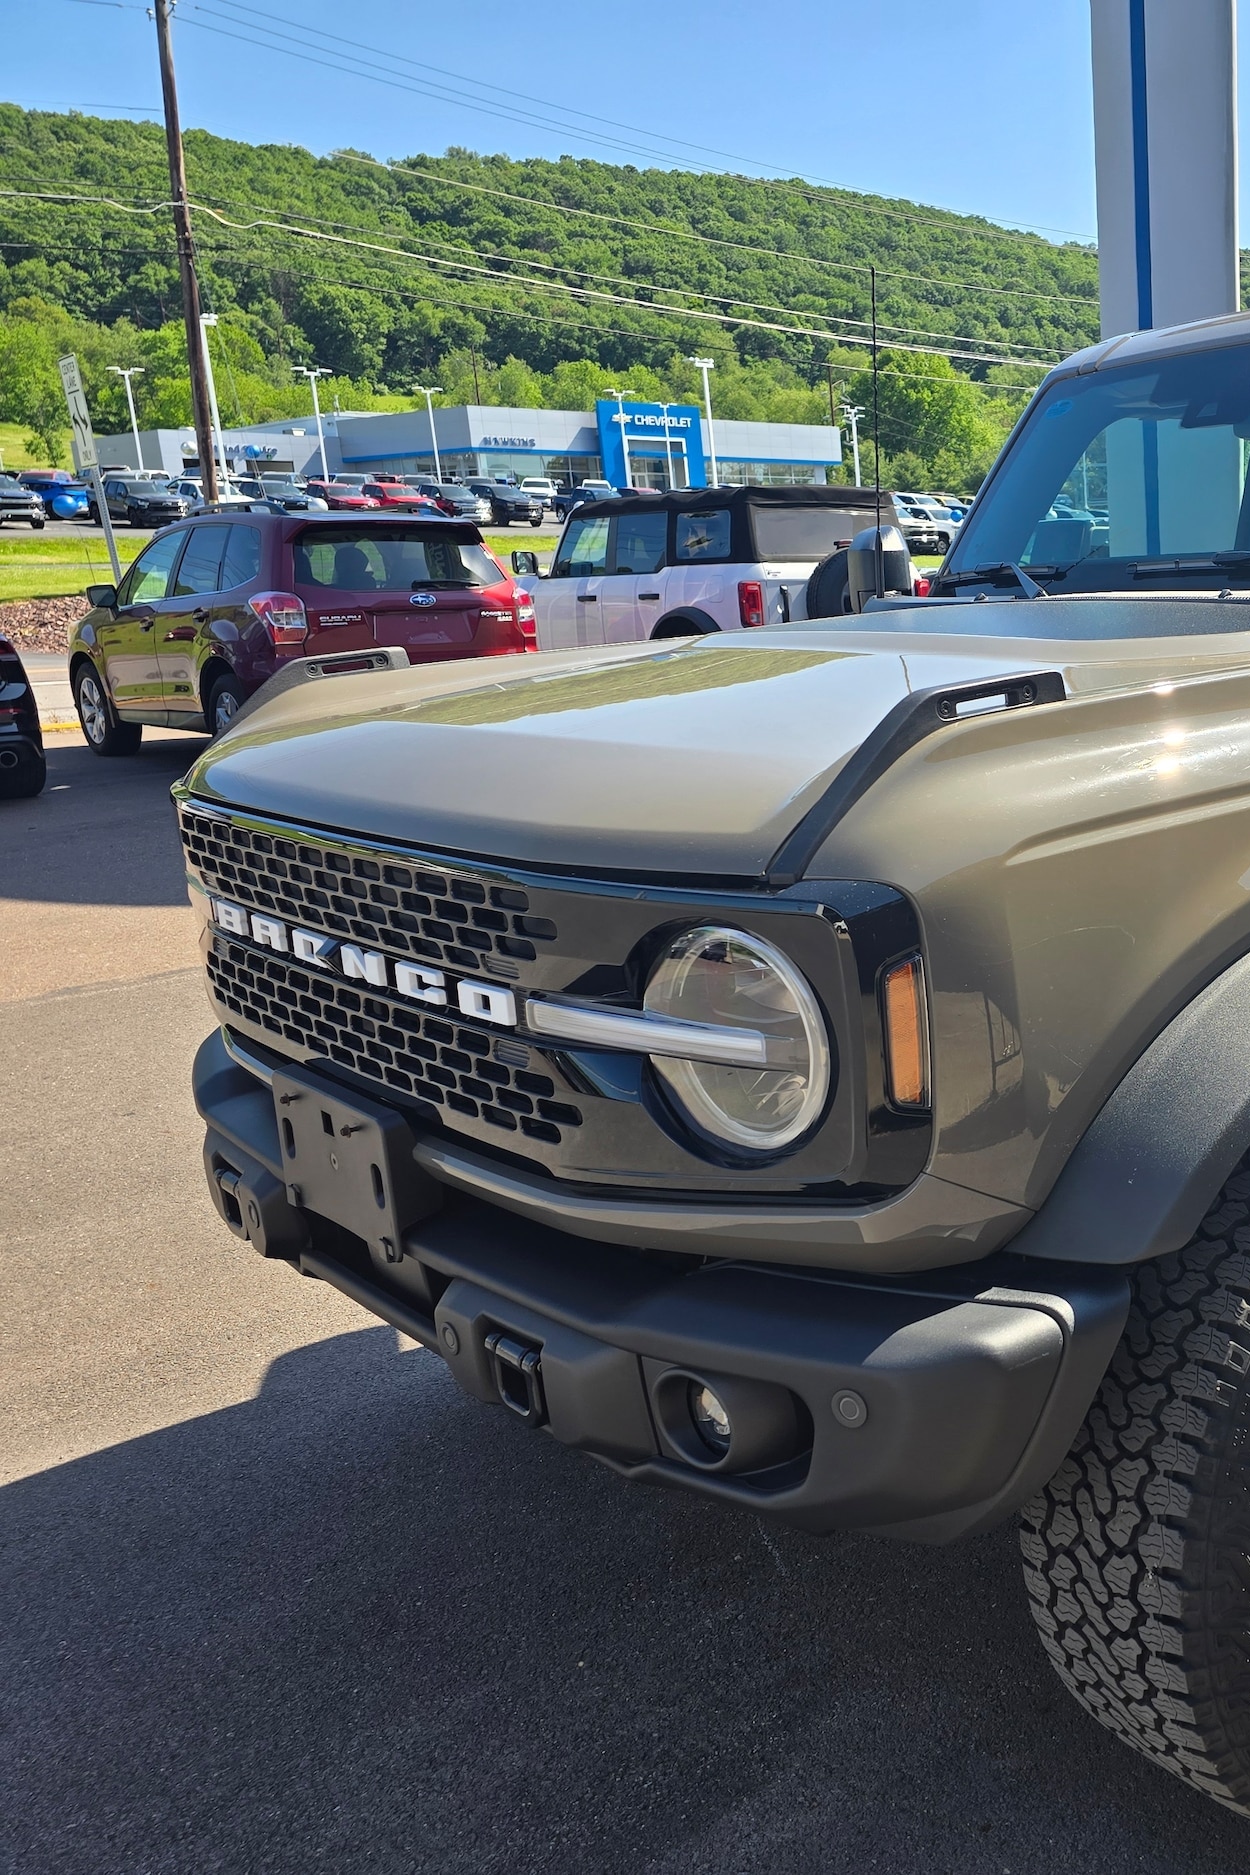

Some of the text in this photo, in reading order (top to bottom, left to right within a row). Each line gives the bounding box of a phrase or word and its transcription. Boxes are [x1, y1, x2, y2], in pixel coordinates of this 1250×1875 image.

[634, 414, 692, 428] CHEVROLET
[482, 436, 536, 447] HAWKINS
[214, 898, 518, 1027] BRONCO
